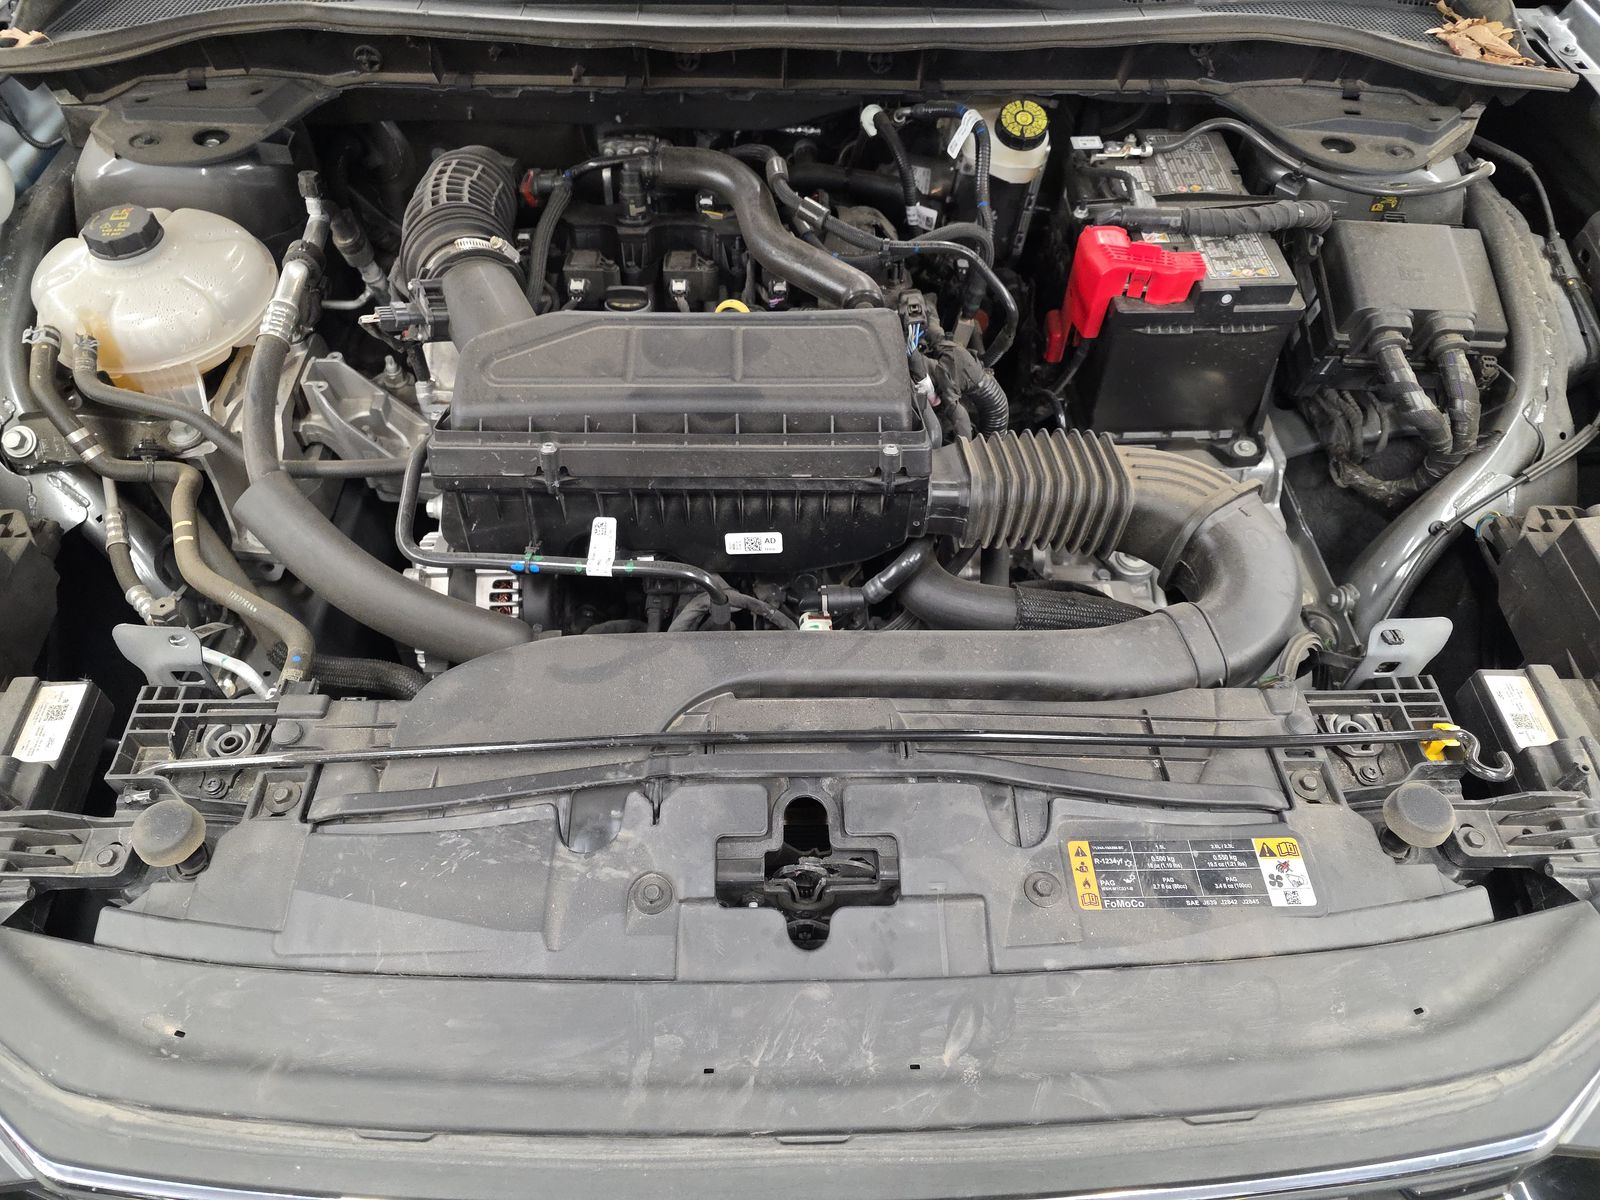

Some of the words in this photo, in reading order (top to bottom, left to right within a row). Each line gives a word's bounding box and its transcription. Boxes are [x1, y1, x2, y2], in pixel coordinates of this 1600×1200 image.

[1094, 857, 1123, 866] R-1234yf
[1166, 855, 1175, 863] kg
[1100, 879, 1116, 887] PAG
[1104, 900, 1145, 908] FoMoCo
